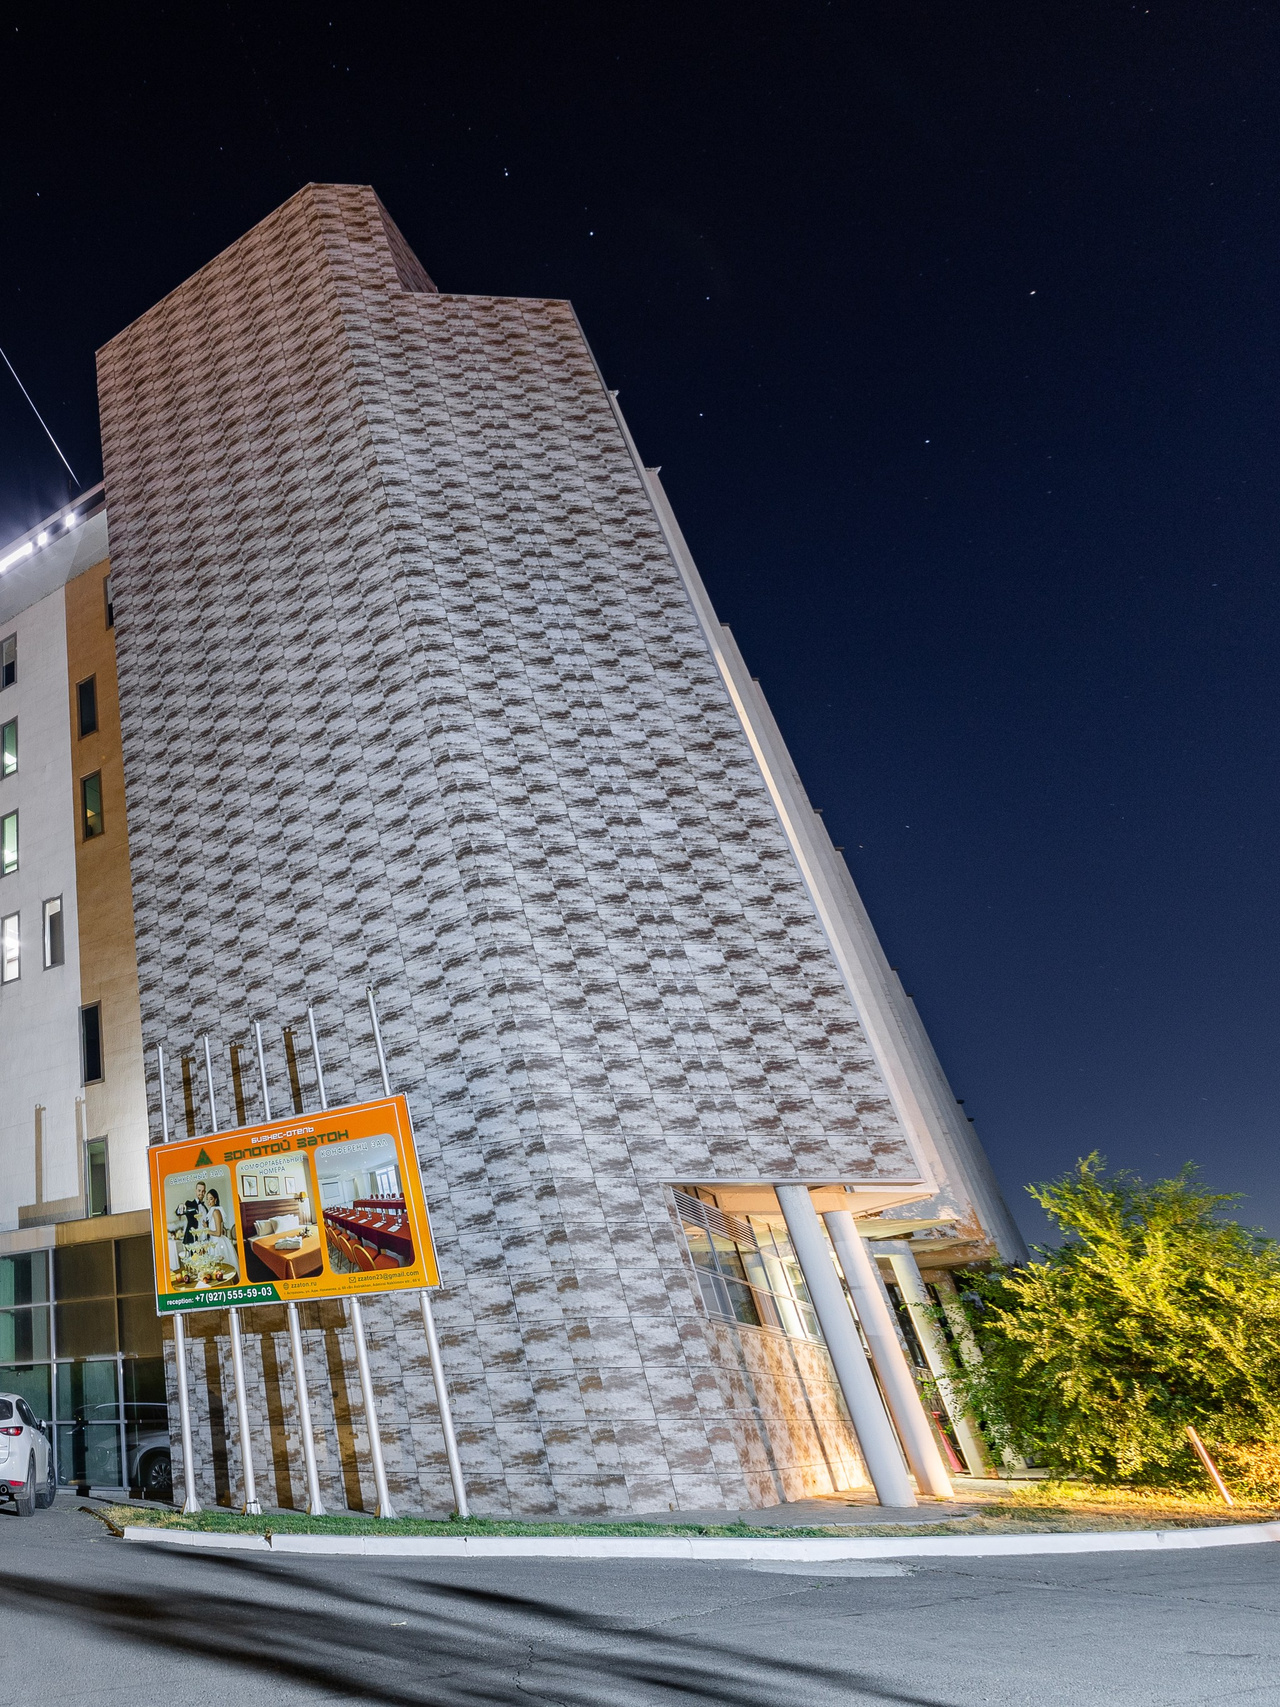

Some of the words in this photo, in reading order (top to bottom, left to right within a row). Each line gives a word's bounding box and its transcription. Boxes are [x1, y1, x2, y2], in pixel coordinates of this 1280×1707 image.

[224, 1139, 291, 1162] ЗОЛОТОЙ
[296, 1129, 349, 1148] ЗАТОН
[320, 1142, 368, 1158] КОНФЕРЕНЦ
[370, 1138, 389, 1149] ЗАЛ
[240, 1154, 304, 1171] КОМФОРТАБЕЛЬНЫЕ
[258, 1165, 286, 1176] НОМЕРА
[169, 1170, 208, 1186] БАНКЕТНЫЙ
[209, 1168, 224, 1178] ЗАЛ
[357, 1270, 420, 1282] zzaton23@gmail.com
[291, 1281, 317, 1289] zzaton.ru
[166, 1297, 194, 1306] reception:
[227, 1286, 273, 1300] 555-59-03
